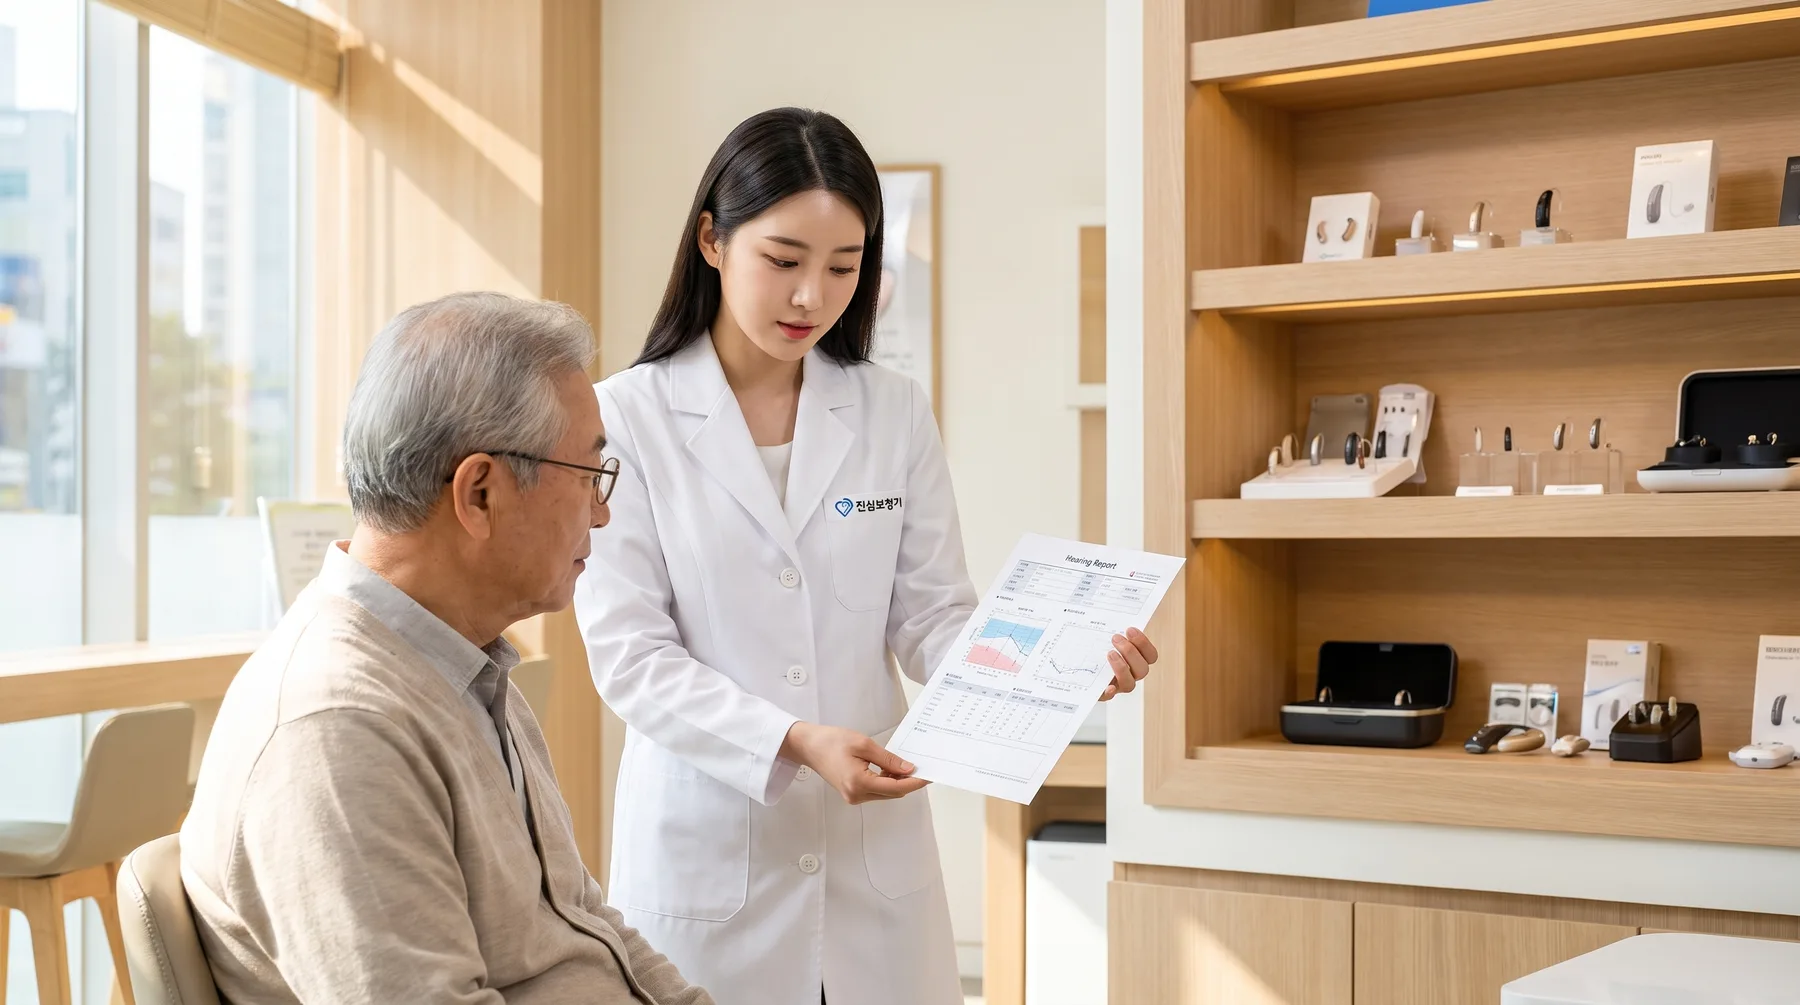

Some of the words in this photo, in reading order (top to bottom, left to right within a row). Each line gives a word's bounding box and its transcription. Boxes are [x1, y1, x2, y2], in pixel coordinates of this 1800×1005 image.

[856, 497, 902, 512] 진심보청기
[1065, 554, 1092, 567] Hearing
[1093, 559, 1117, 569] Report
